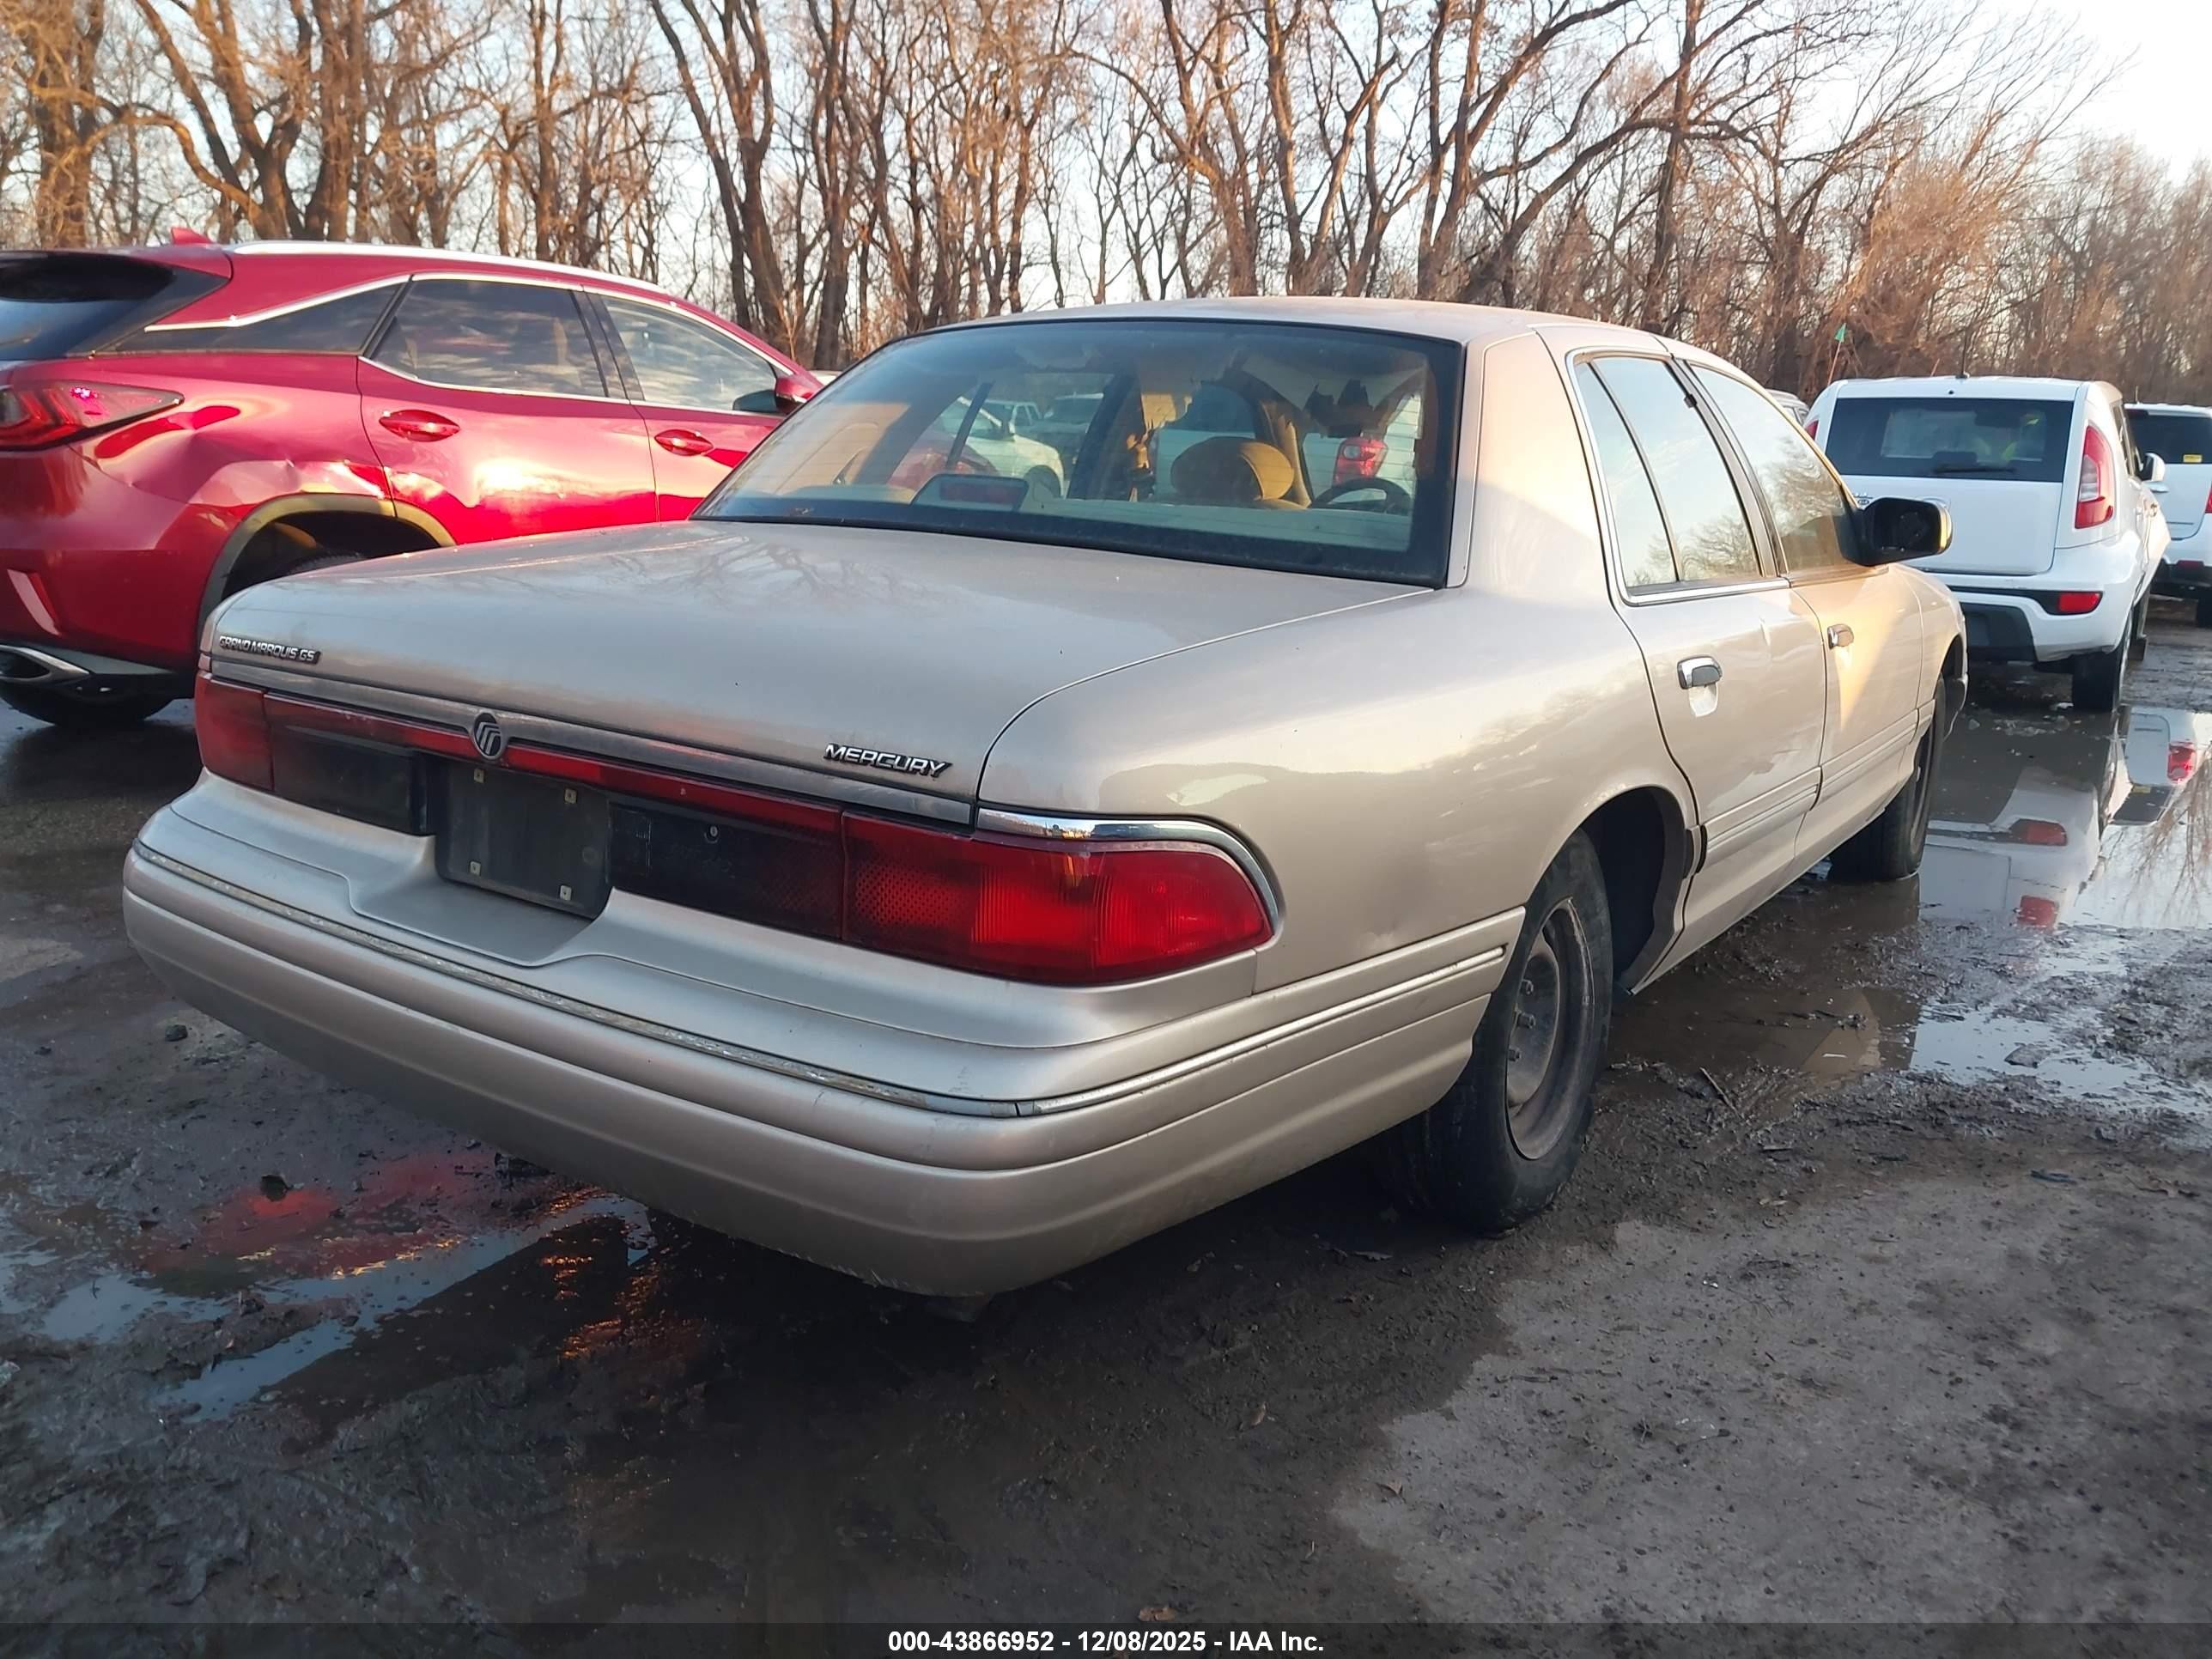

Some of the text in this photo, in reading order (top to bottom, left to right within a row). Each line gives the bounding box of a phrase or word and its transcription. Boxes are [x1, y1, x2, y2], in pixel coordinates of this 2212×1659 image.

[219, 635, 317, 662] GRAND MARQUIS GS
[824, 744, 949, 776] MERCURY
